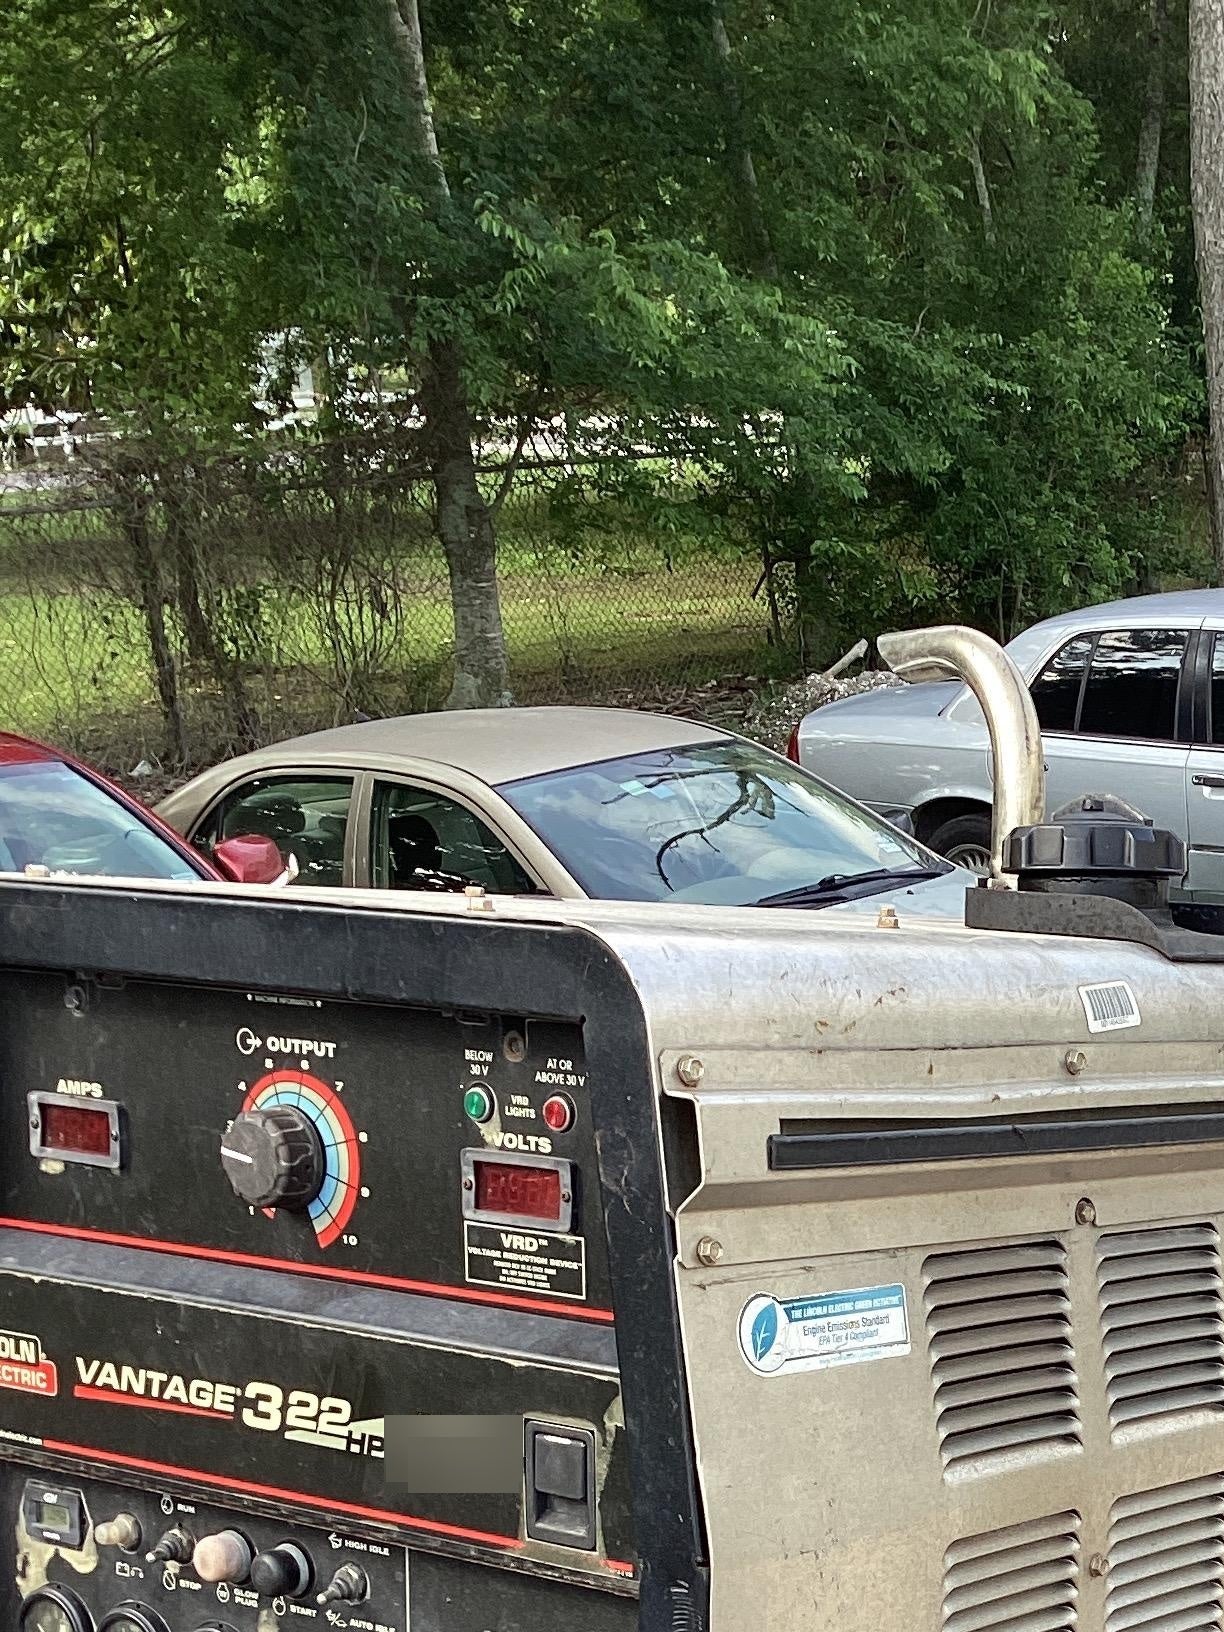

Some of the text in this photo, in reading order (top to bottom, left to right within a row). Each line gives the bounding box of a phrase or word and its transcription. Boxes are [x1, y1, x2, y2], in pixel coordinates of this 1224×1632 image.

[266, 1036, 337, 1058] OUTPUT
[464, 1049, 493, 1063] BELOW
[470, 1064, 489, 1077] 30 V
[547, 1058, 573, 1072] AT OR
[535, 1071, 565, 1085] ABOVE
[566, 1074, 577, 1086] 30
[56, 1078, 104, 1099] AMPS
[237, 1081, 247, 1092] 4
[334, 1081, 345, 1092] 7
[504, 1105, 536, 1120] LIGHTS
[492, 1131, 553, 1154] VOLTS
[342, 1234, 359, 1247] 10
[803, 1313, 890, 1337] Engine Emissions Standard
[818, 1334, 831, 1346] EPA
[832, 1332, 843, 1344] Tier
[0, 1364, 48, 1389] CTRIC
[75, 1356, 353, 1435] VANTAGE 322
[176, 1503, 196, 1514] RUN
[344, 1539, 390, 1556] HIGH IDLE
[179, 1578, 202, 1591] STOP
[233, 1587, 259, 1600] GLOW
[234, 1595, 259, 1608] PLUG
[289, 1604, 318, 1618] START
[349, 1618, 374, 1631] AUTO
